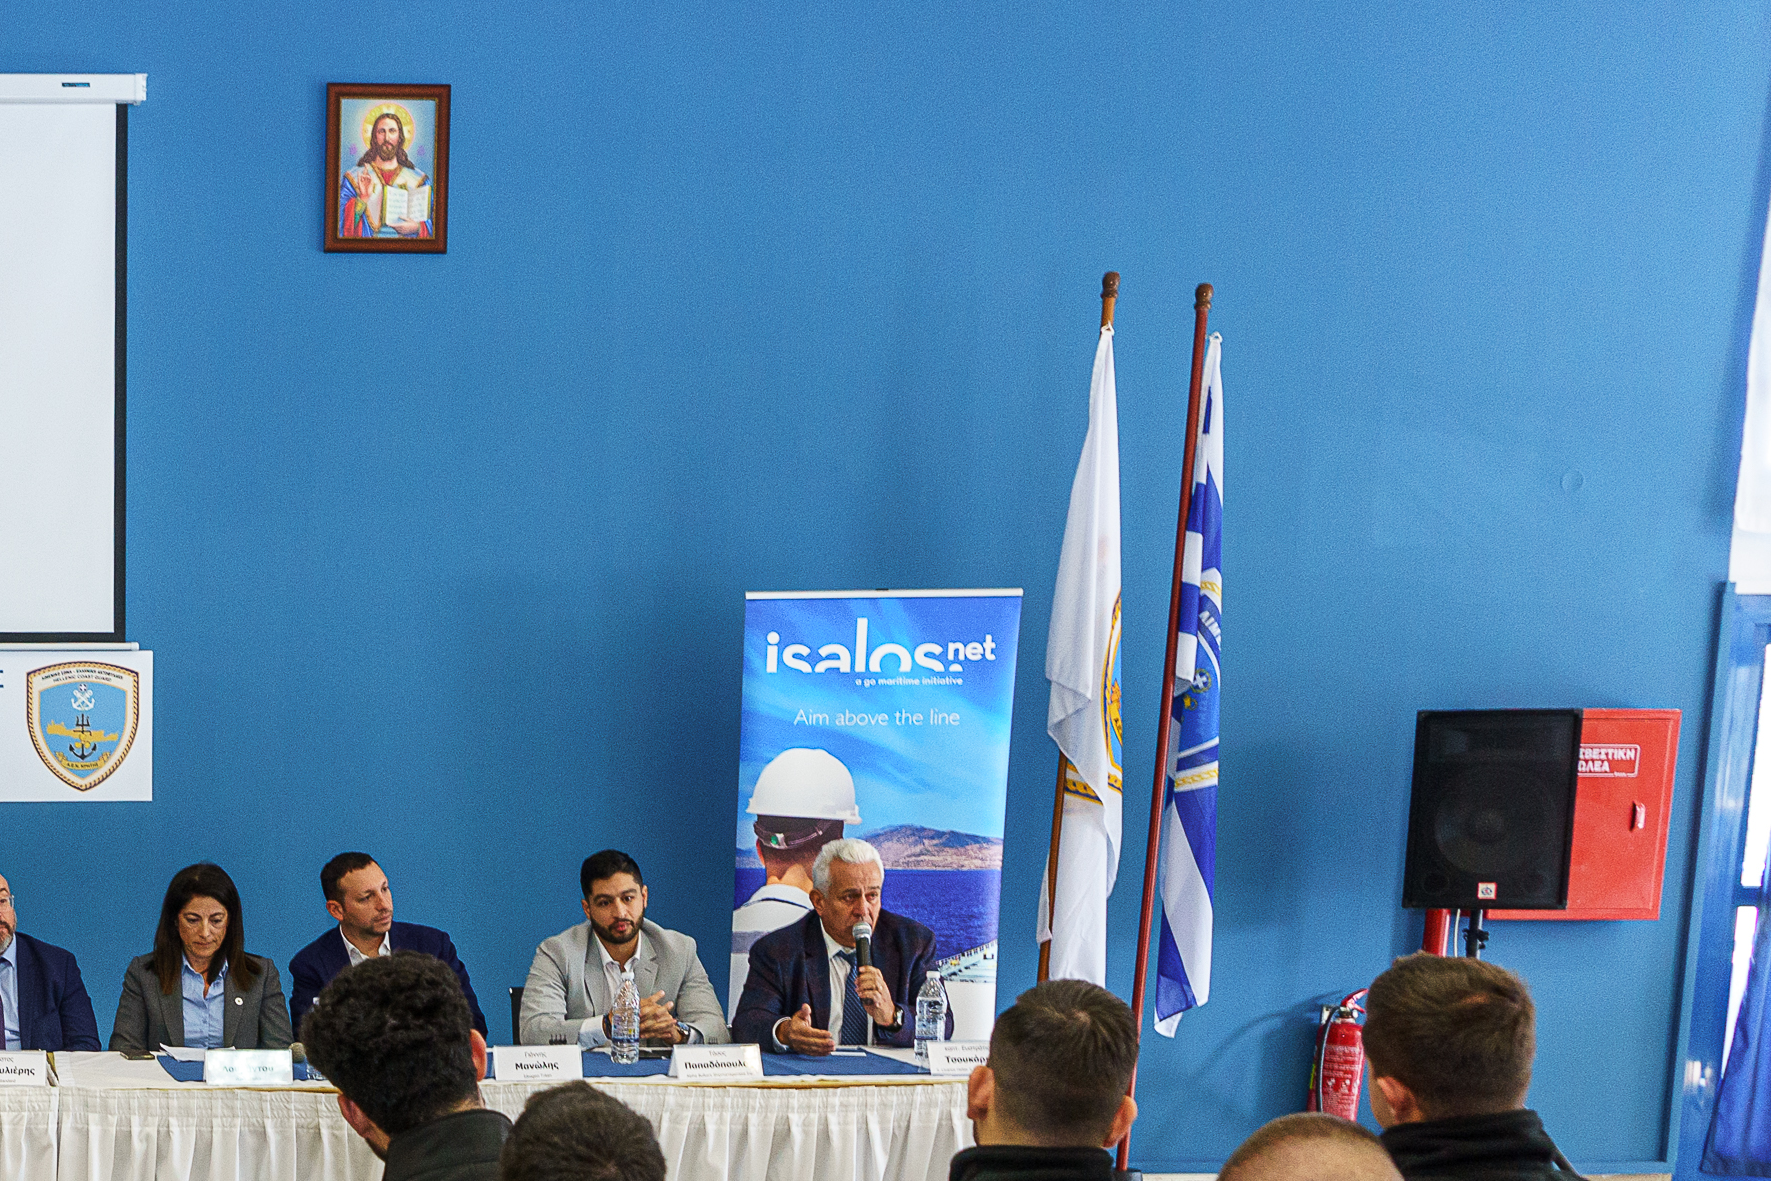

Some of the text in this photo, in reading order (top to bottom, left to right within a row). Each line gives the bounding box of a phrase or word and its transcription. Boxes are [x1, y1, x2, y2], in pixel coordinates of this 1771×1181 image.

[878, 675, 920, 686] maritime
[921, 675, 963, 686] initiative
[793, 708, 961, 726] Aim above the line
[1579, 748, 1636, 761] ΣΒΕΣΤΙΚΗ
[1577, 760, 1611, 773] ΩΛΕΑ
[944, 1053, 989, 1065] Τσουκάρ
[514, 1060, 560, 1071] Μανώλης
